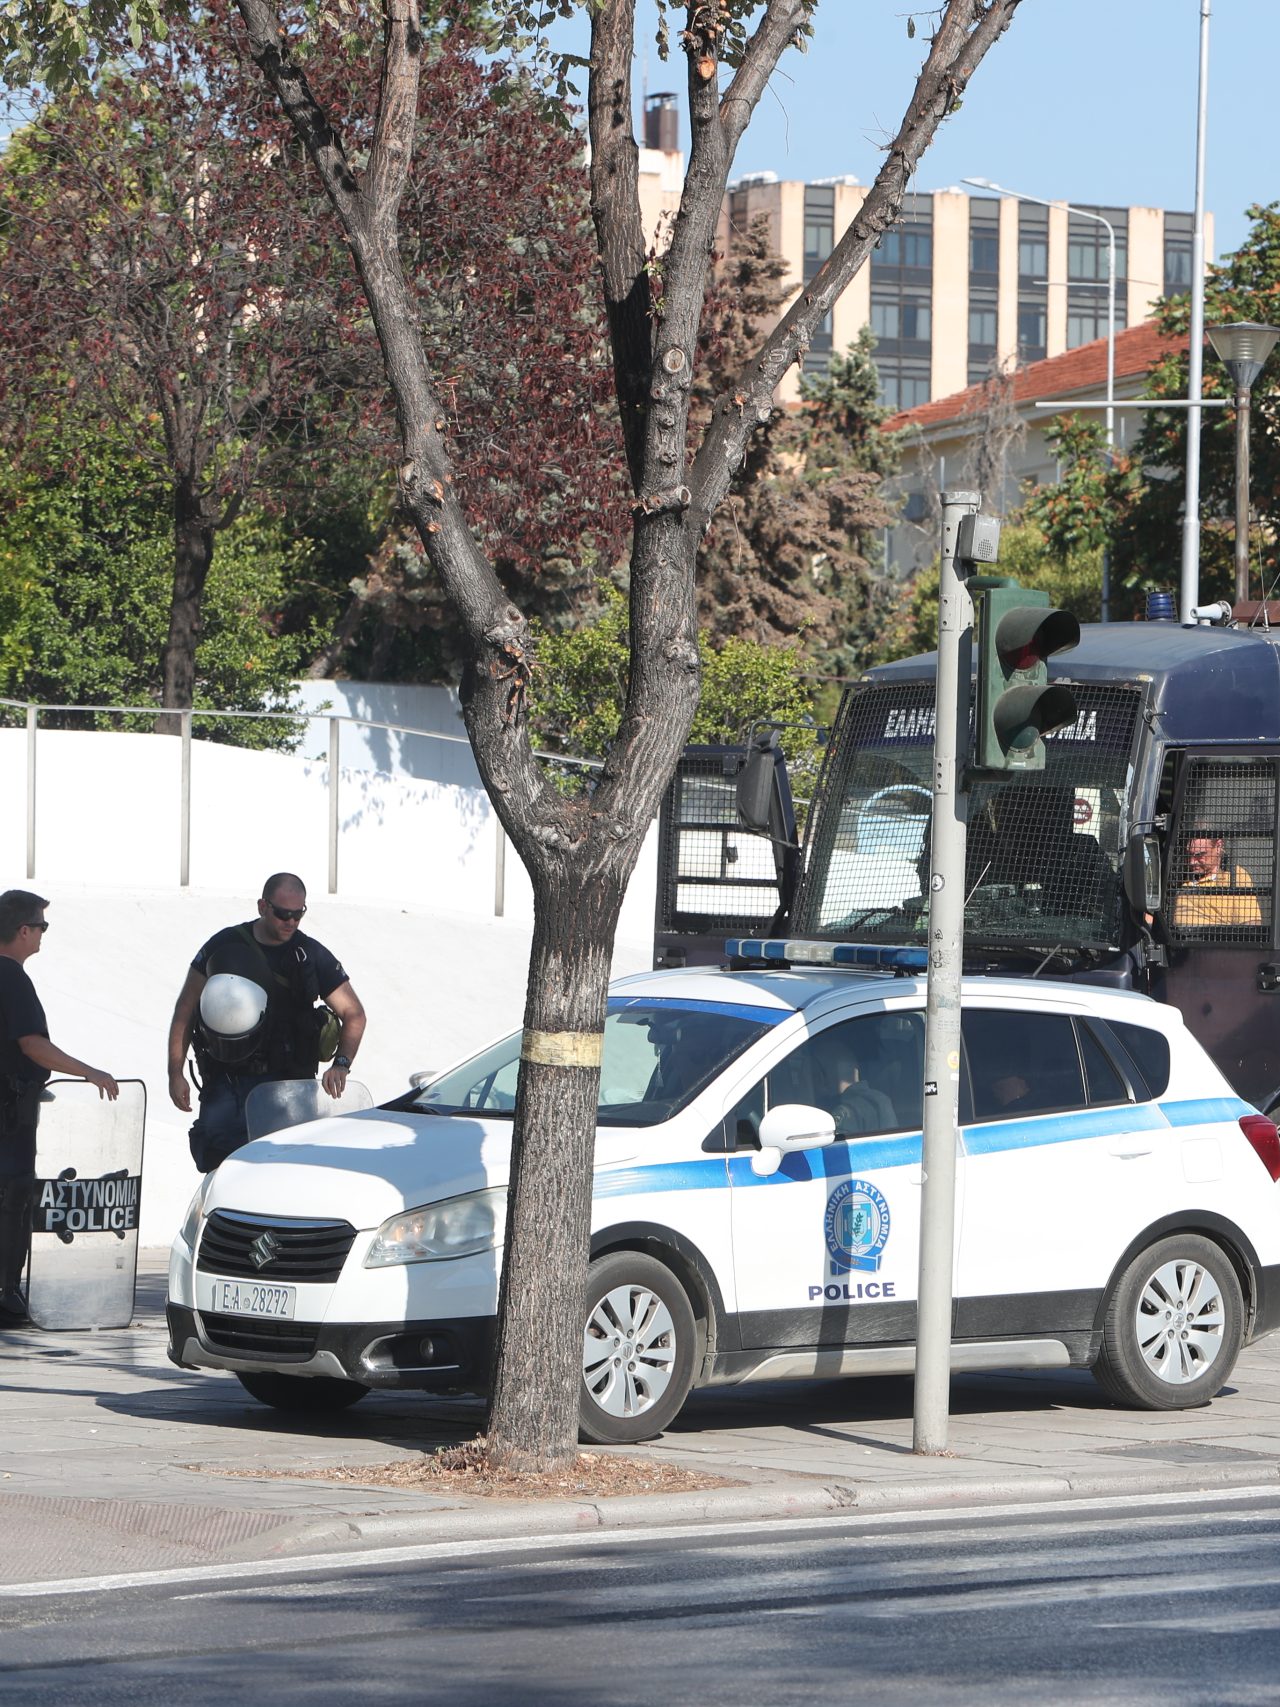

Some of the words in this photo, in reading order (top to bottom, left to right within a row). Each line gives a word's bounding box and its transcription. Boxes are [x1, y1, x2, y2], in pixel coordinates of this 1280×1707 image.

[40, 1178, 137, 1208] ΑΣΤΥΝΟΜΙΑ
[45, 1206, 135, 1230] POLICE
[825, 1183, 850, 1253] ΕΛΛΗΝΙΚΗ
[855, 1181, 889, 1249] ΑΣΤΥΝΟΜΙΑ
[251, 1286, 289, 1315] 28272
[808, 1282, 896, 1301] POLICE
